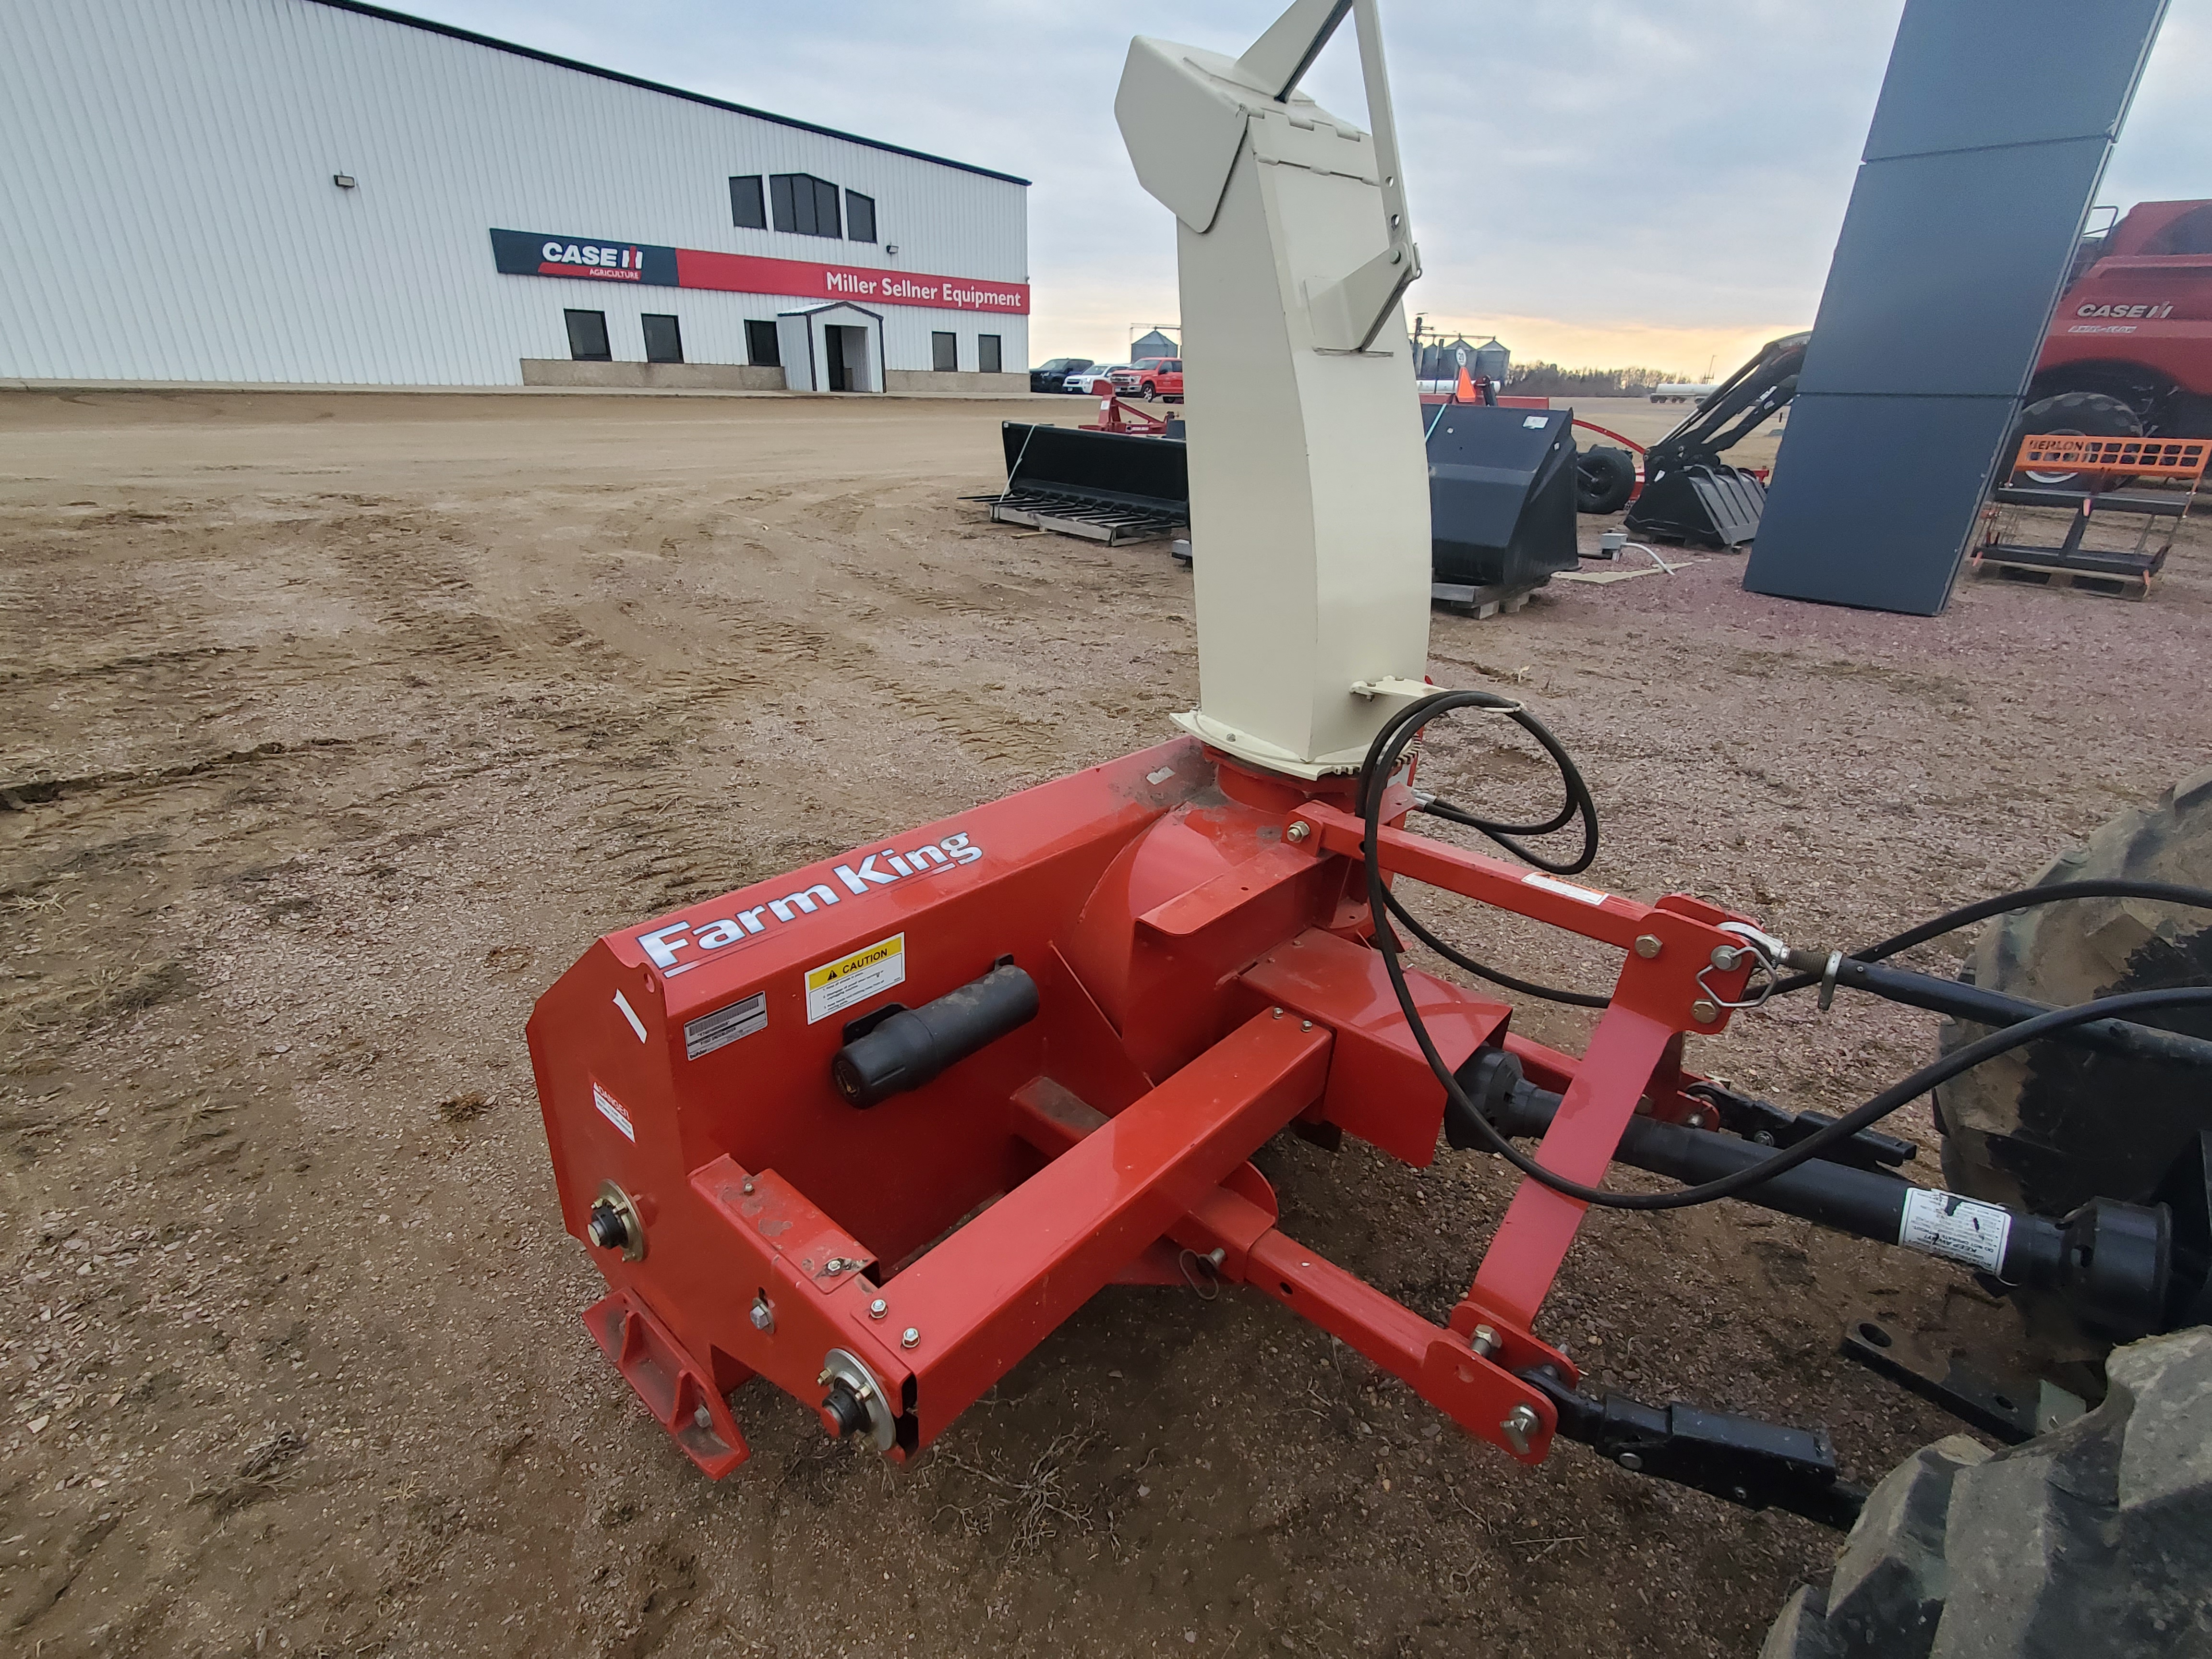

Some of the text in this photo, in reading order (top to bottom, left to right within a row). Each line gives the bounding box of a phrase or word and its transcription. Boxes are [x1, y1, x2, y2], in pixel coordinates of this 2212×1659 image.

[542, 241, 618, 267] CASE
[589, 268, 639, 279] AGRICULTURE
[826, 272, 1022, 309] Miller Sellner Equipment
[2077, 304, 2149, 318] CASE
[635, 831, 983, 970] Farm King
[842, 948, 888, 974] CAUTION
[598, 1085, 630, 1120] DANGER
[1923, 1234, 1952, 1246] AWY!
[1952, 1242, 1977, 1253] KEEP
